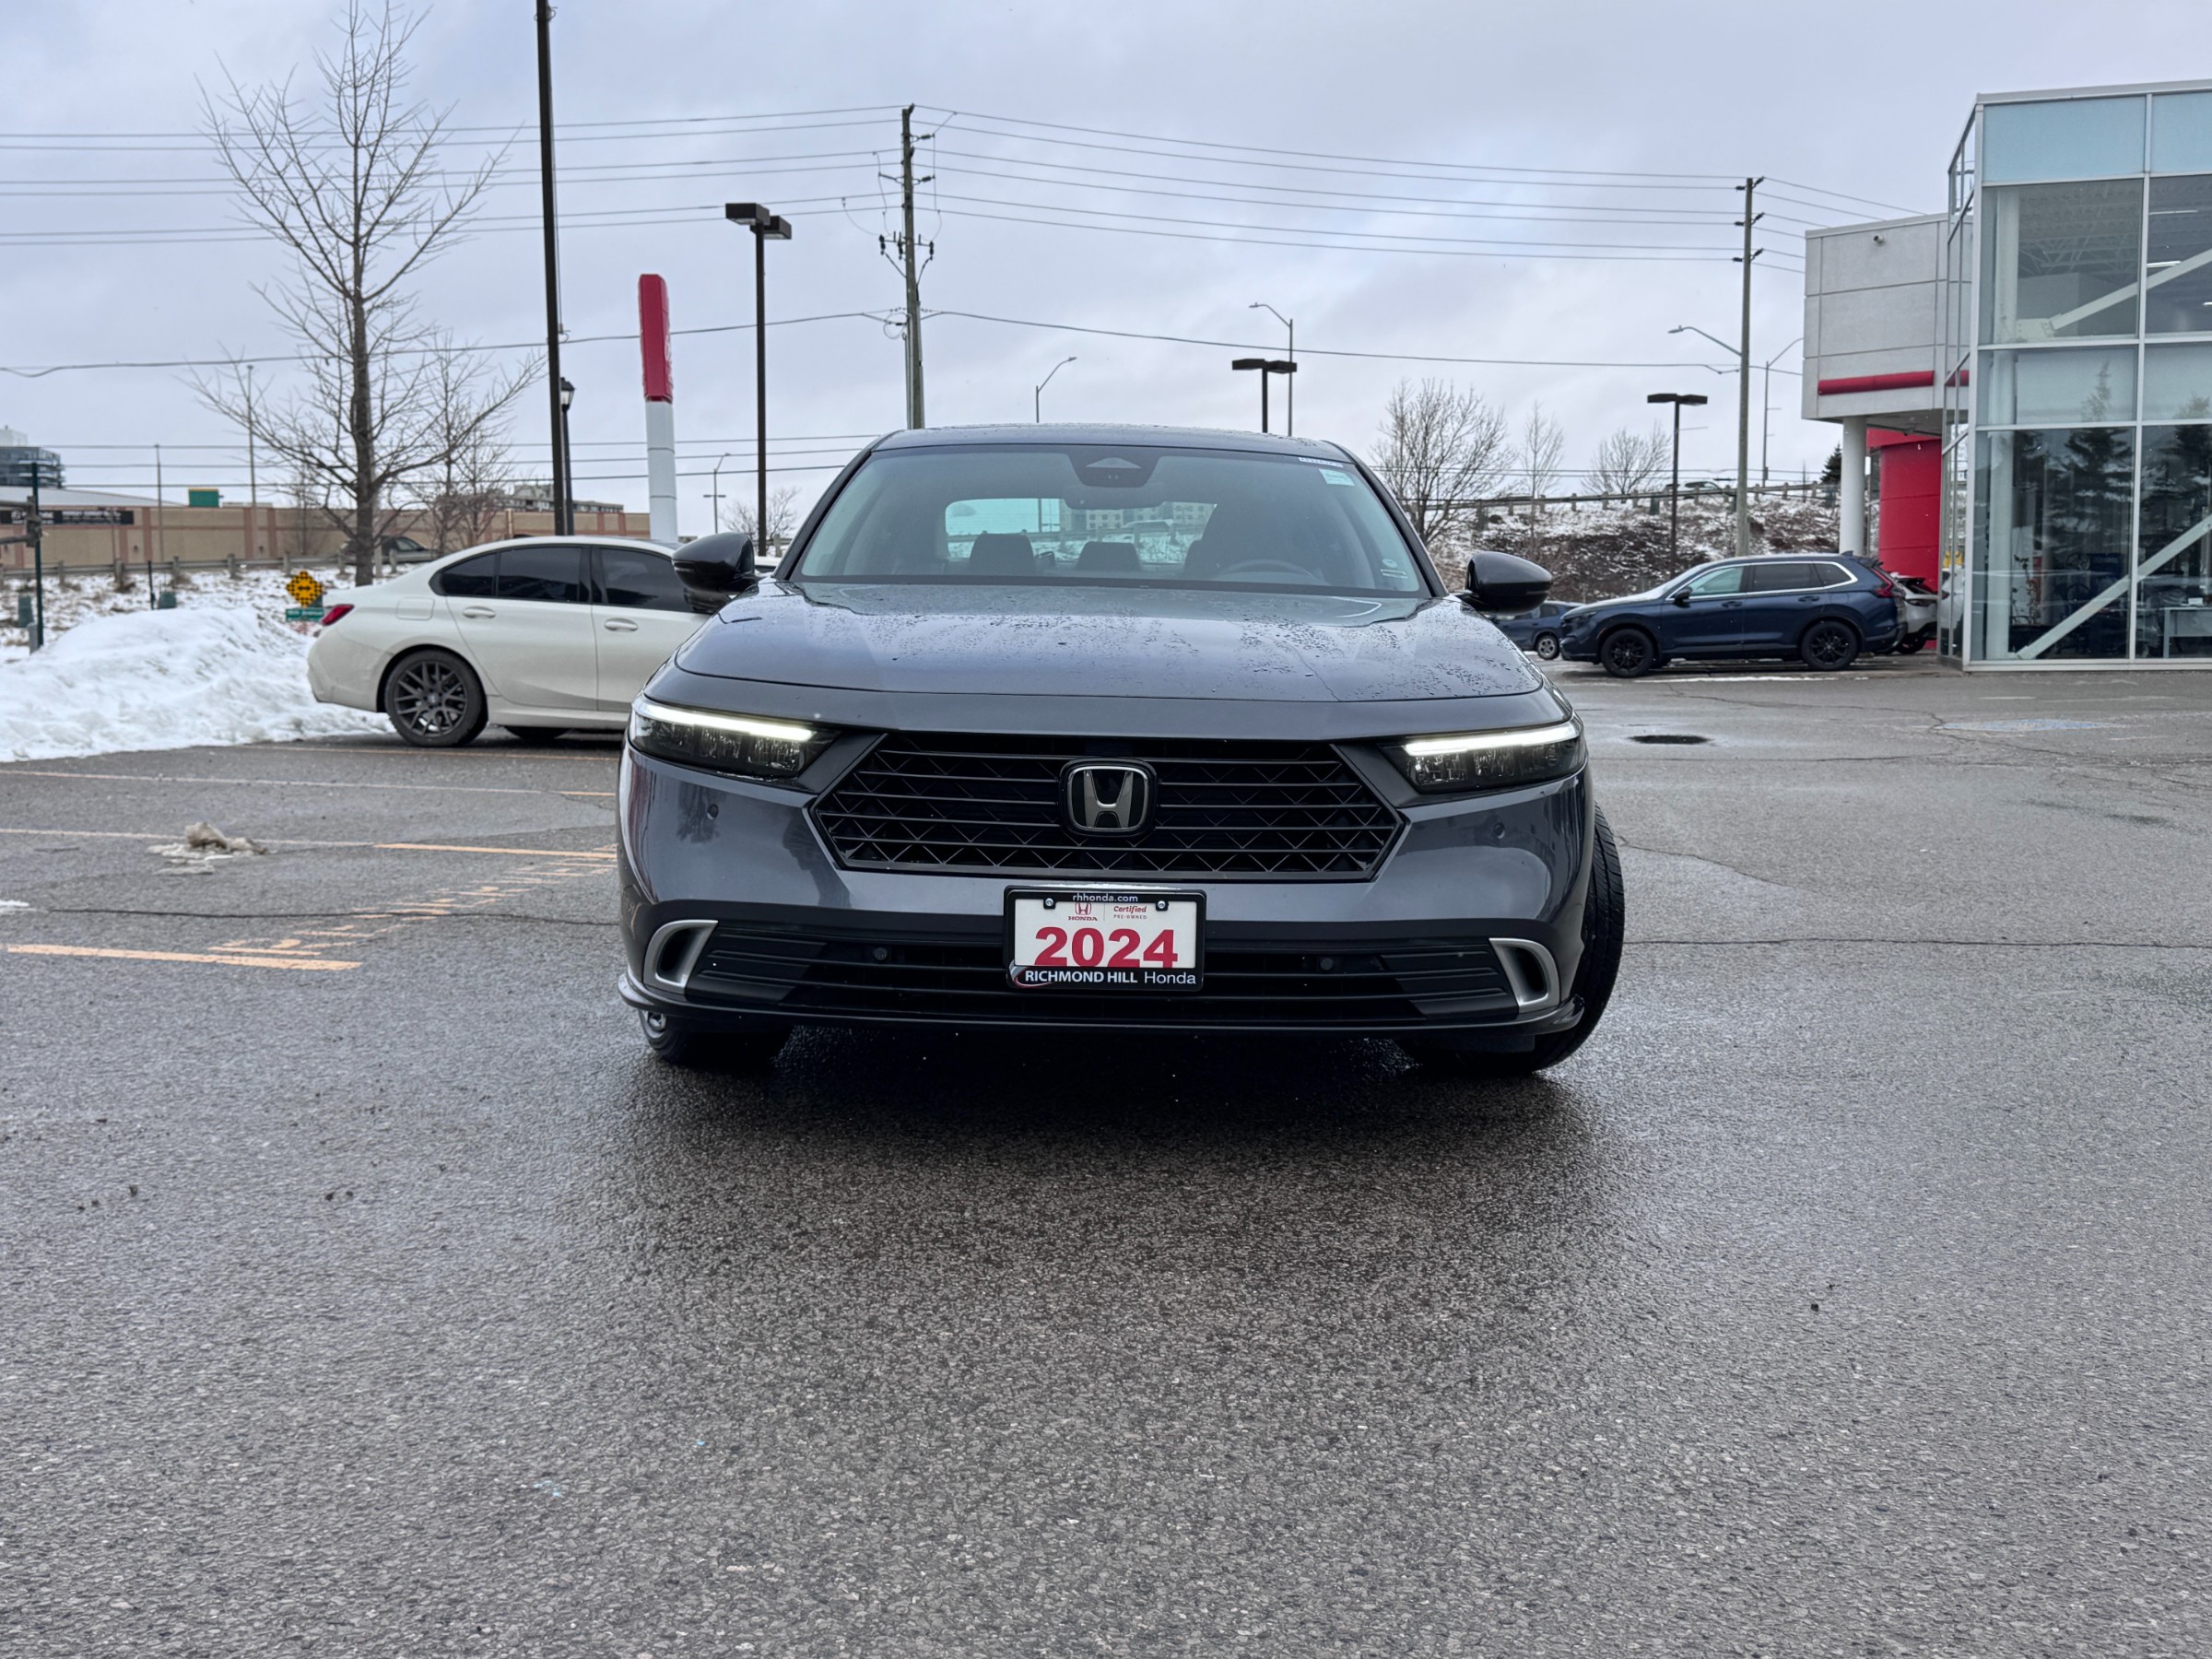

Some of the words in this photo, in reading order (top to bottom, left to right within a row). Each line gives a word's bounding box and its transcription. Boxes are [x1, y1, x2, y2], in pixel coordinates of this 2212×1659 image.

[1072, 892, 1138, 902] rhhonda.com
[1113, 905, 1147, 914] Certified
[1034, 926, 1179, 969] 2024
[1025, 970, 1105, 982] RICHMOND
[1107, 971, 1138, 983] HILL
[1144, 971, 1196, 984] Honda
